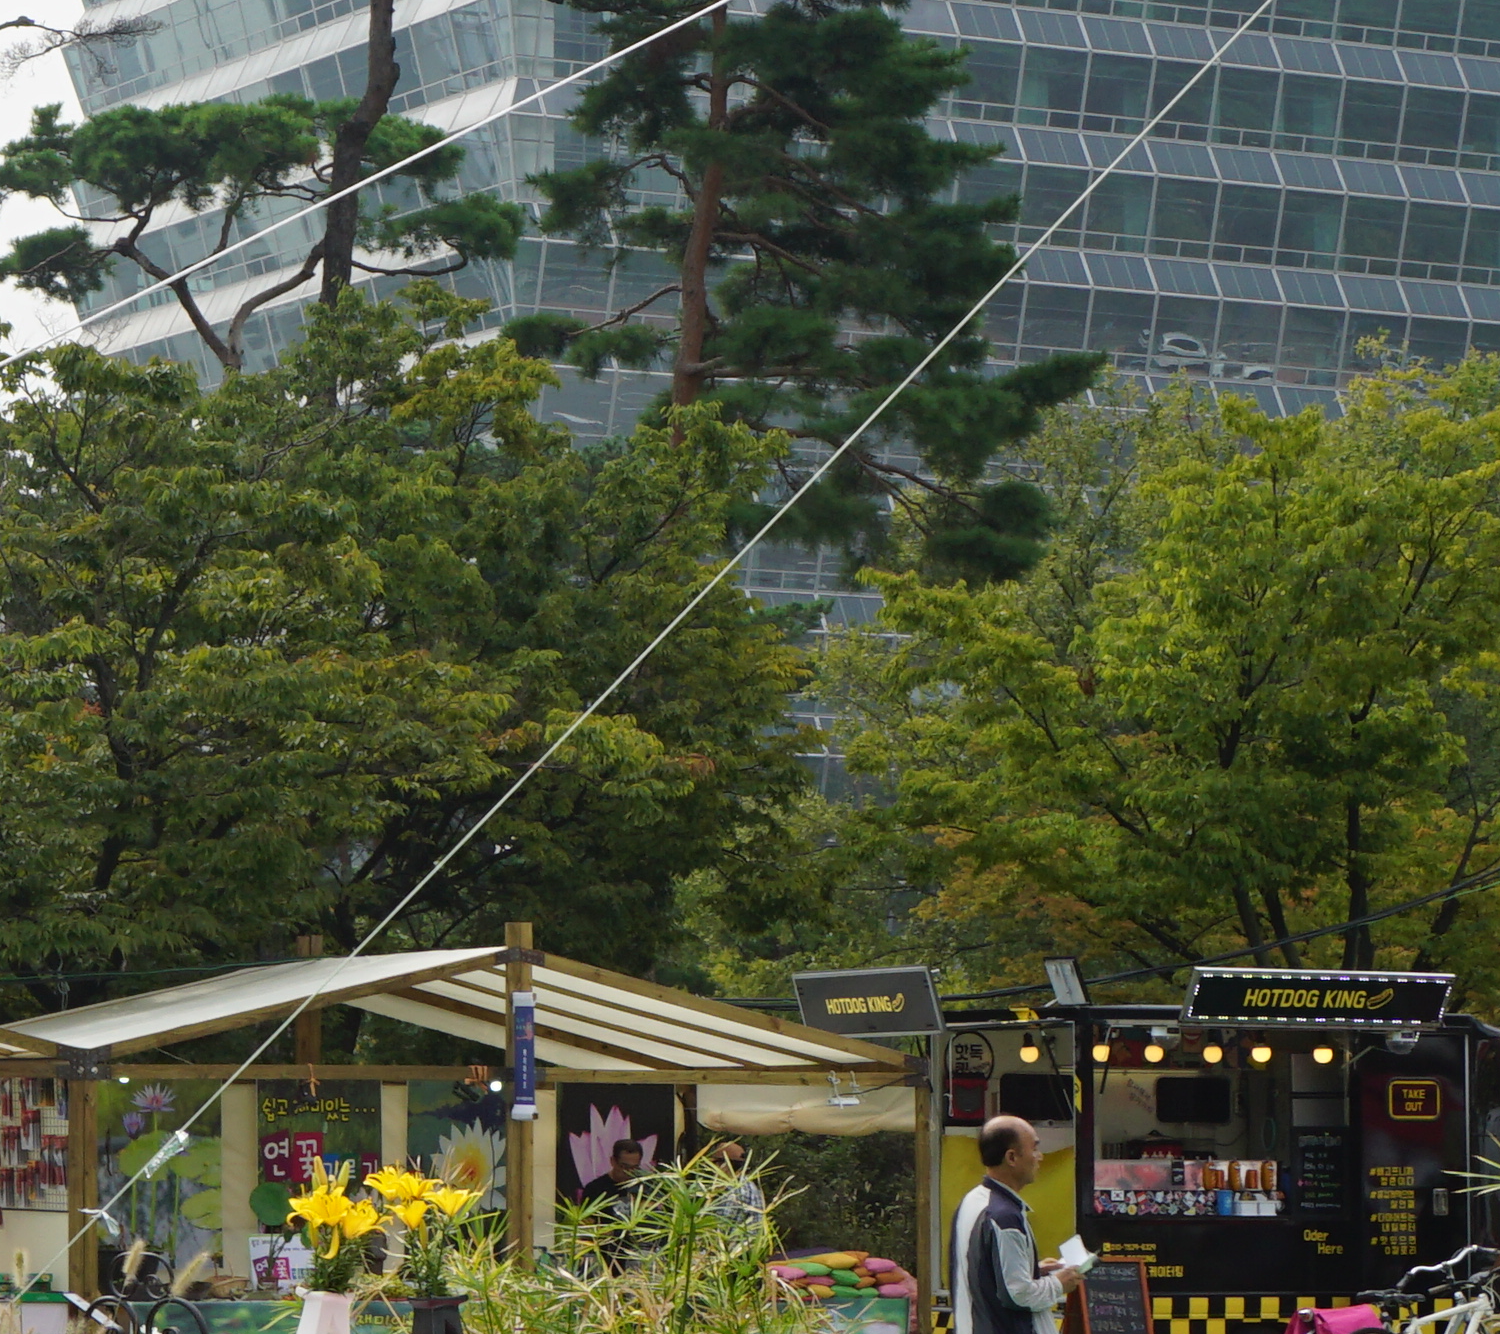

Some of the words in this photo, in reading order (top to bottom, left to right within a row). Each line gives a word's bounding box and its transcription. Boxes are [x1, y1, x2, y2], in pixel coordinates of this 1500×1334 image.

[825, 997, 867, 1015] HOTDOG
[867, 995, 892, 1013] KING
[1243, 988, 1319, 1008] HOTDOG
[1323, 989, 1367, 1009] KING
[1401, 1088, 1426, 1100] TAKE
[262, 1097, 289, 1122] 쉽고
[1404, 1100, 1423, 1112] OUT
[1303, 1229, 1330, 1242] Oder
[1317, 1243, 1344, 1255] Here
